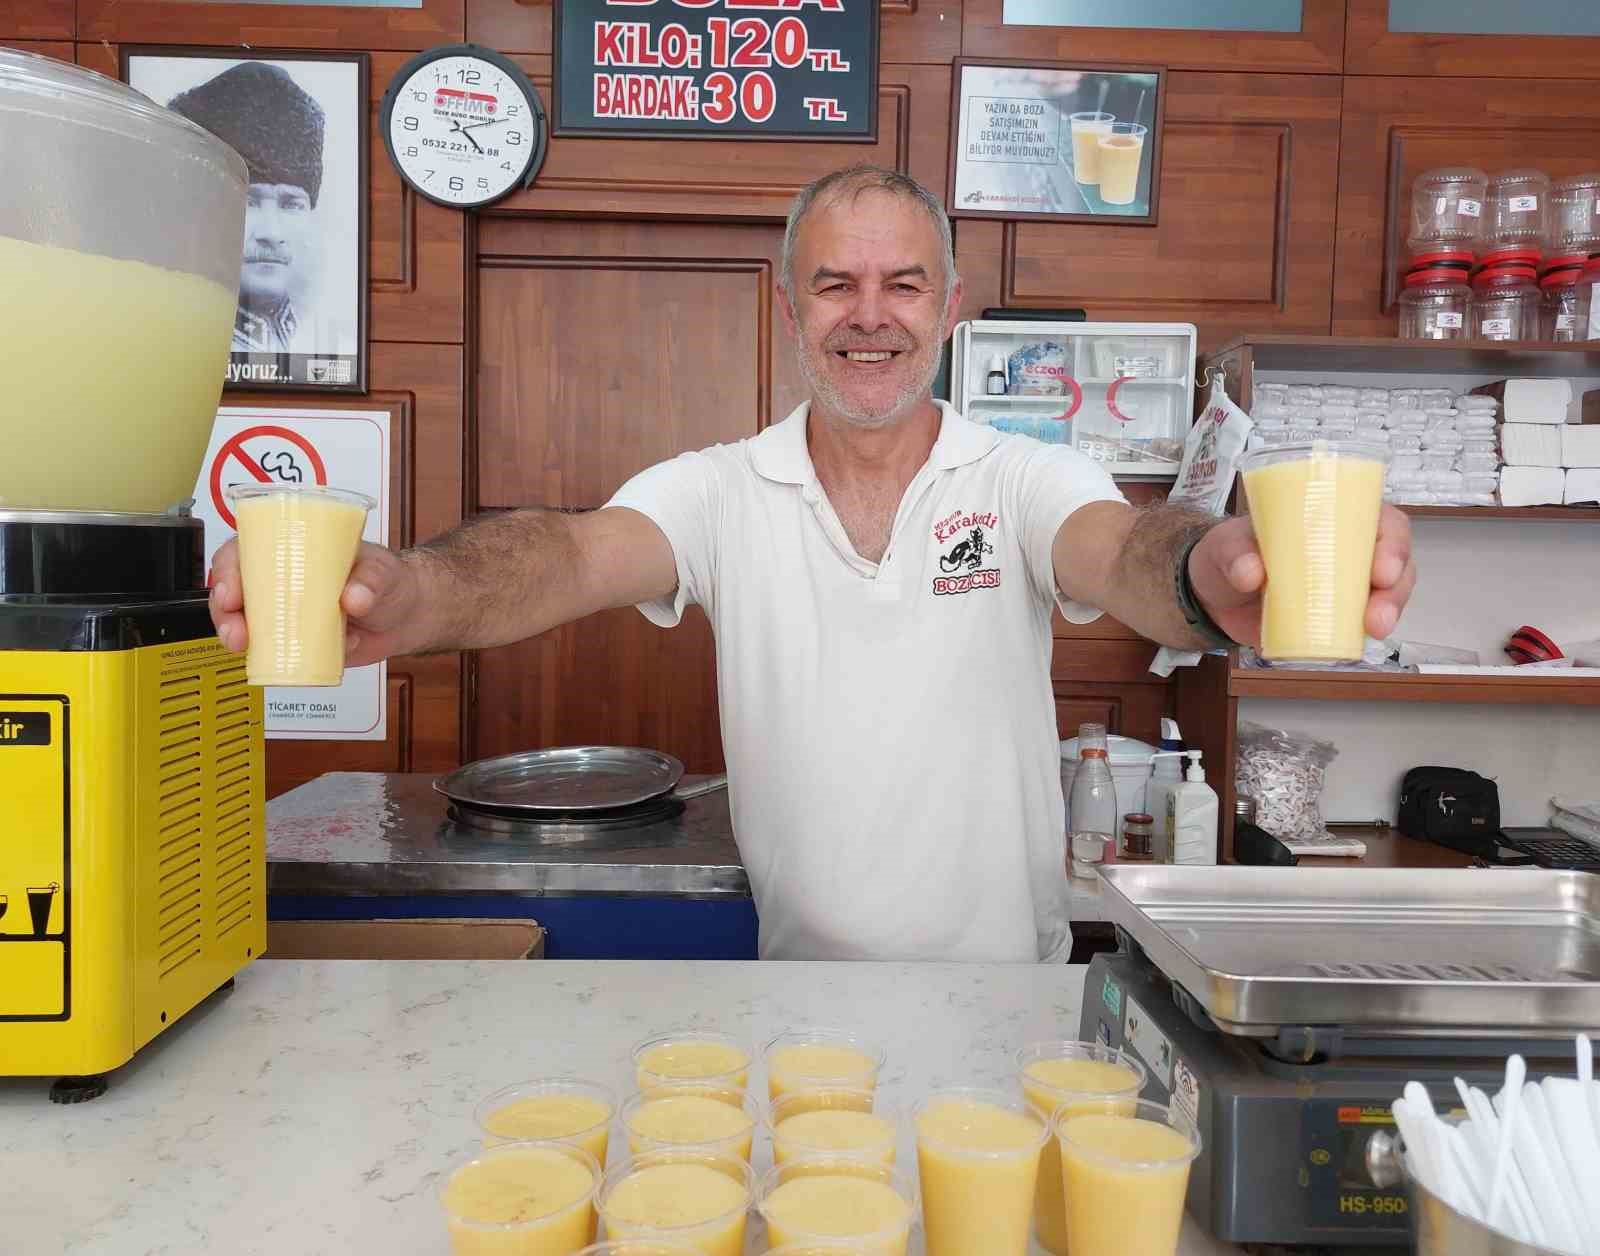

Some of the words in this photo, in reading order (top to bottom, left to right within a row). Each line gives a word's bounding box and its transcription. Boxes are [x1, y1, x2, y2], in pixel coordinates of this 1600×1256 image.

[707, 16, 808, 68] 120
[807, 49, 850, 72] TL
[435, 73, 449, 86] 11
[457, 69, 481, 86] 12
[412, 91, 427, 103] 10
[593, 73, 699, 120] BARDAK:
[702, 70, 777, 123] 30
[803, 97, 848, 121] TL
[506, 105, 518, 117] 2
[404, 116, 419, 131] 9
[506, 130, 521, 146] 3
[407, 146, 418, 157] 8
[500, 160, 512, 171] 4
[423, 169, 436, 183] 7
[477, 177, 489, 189] 5
[449, 176, 464, 191] 6
[269, 700, 306, 711] TİCARET
[309, 703, 337, 712] ODASI
[0, 718, 24, 739] ir
